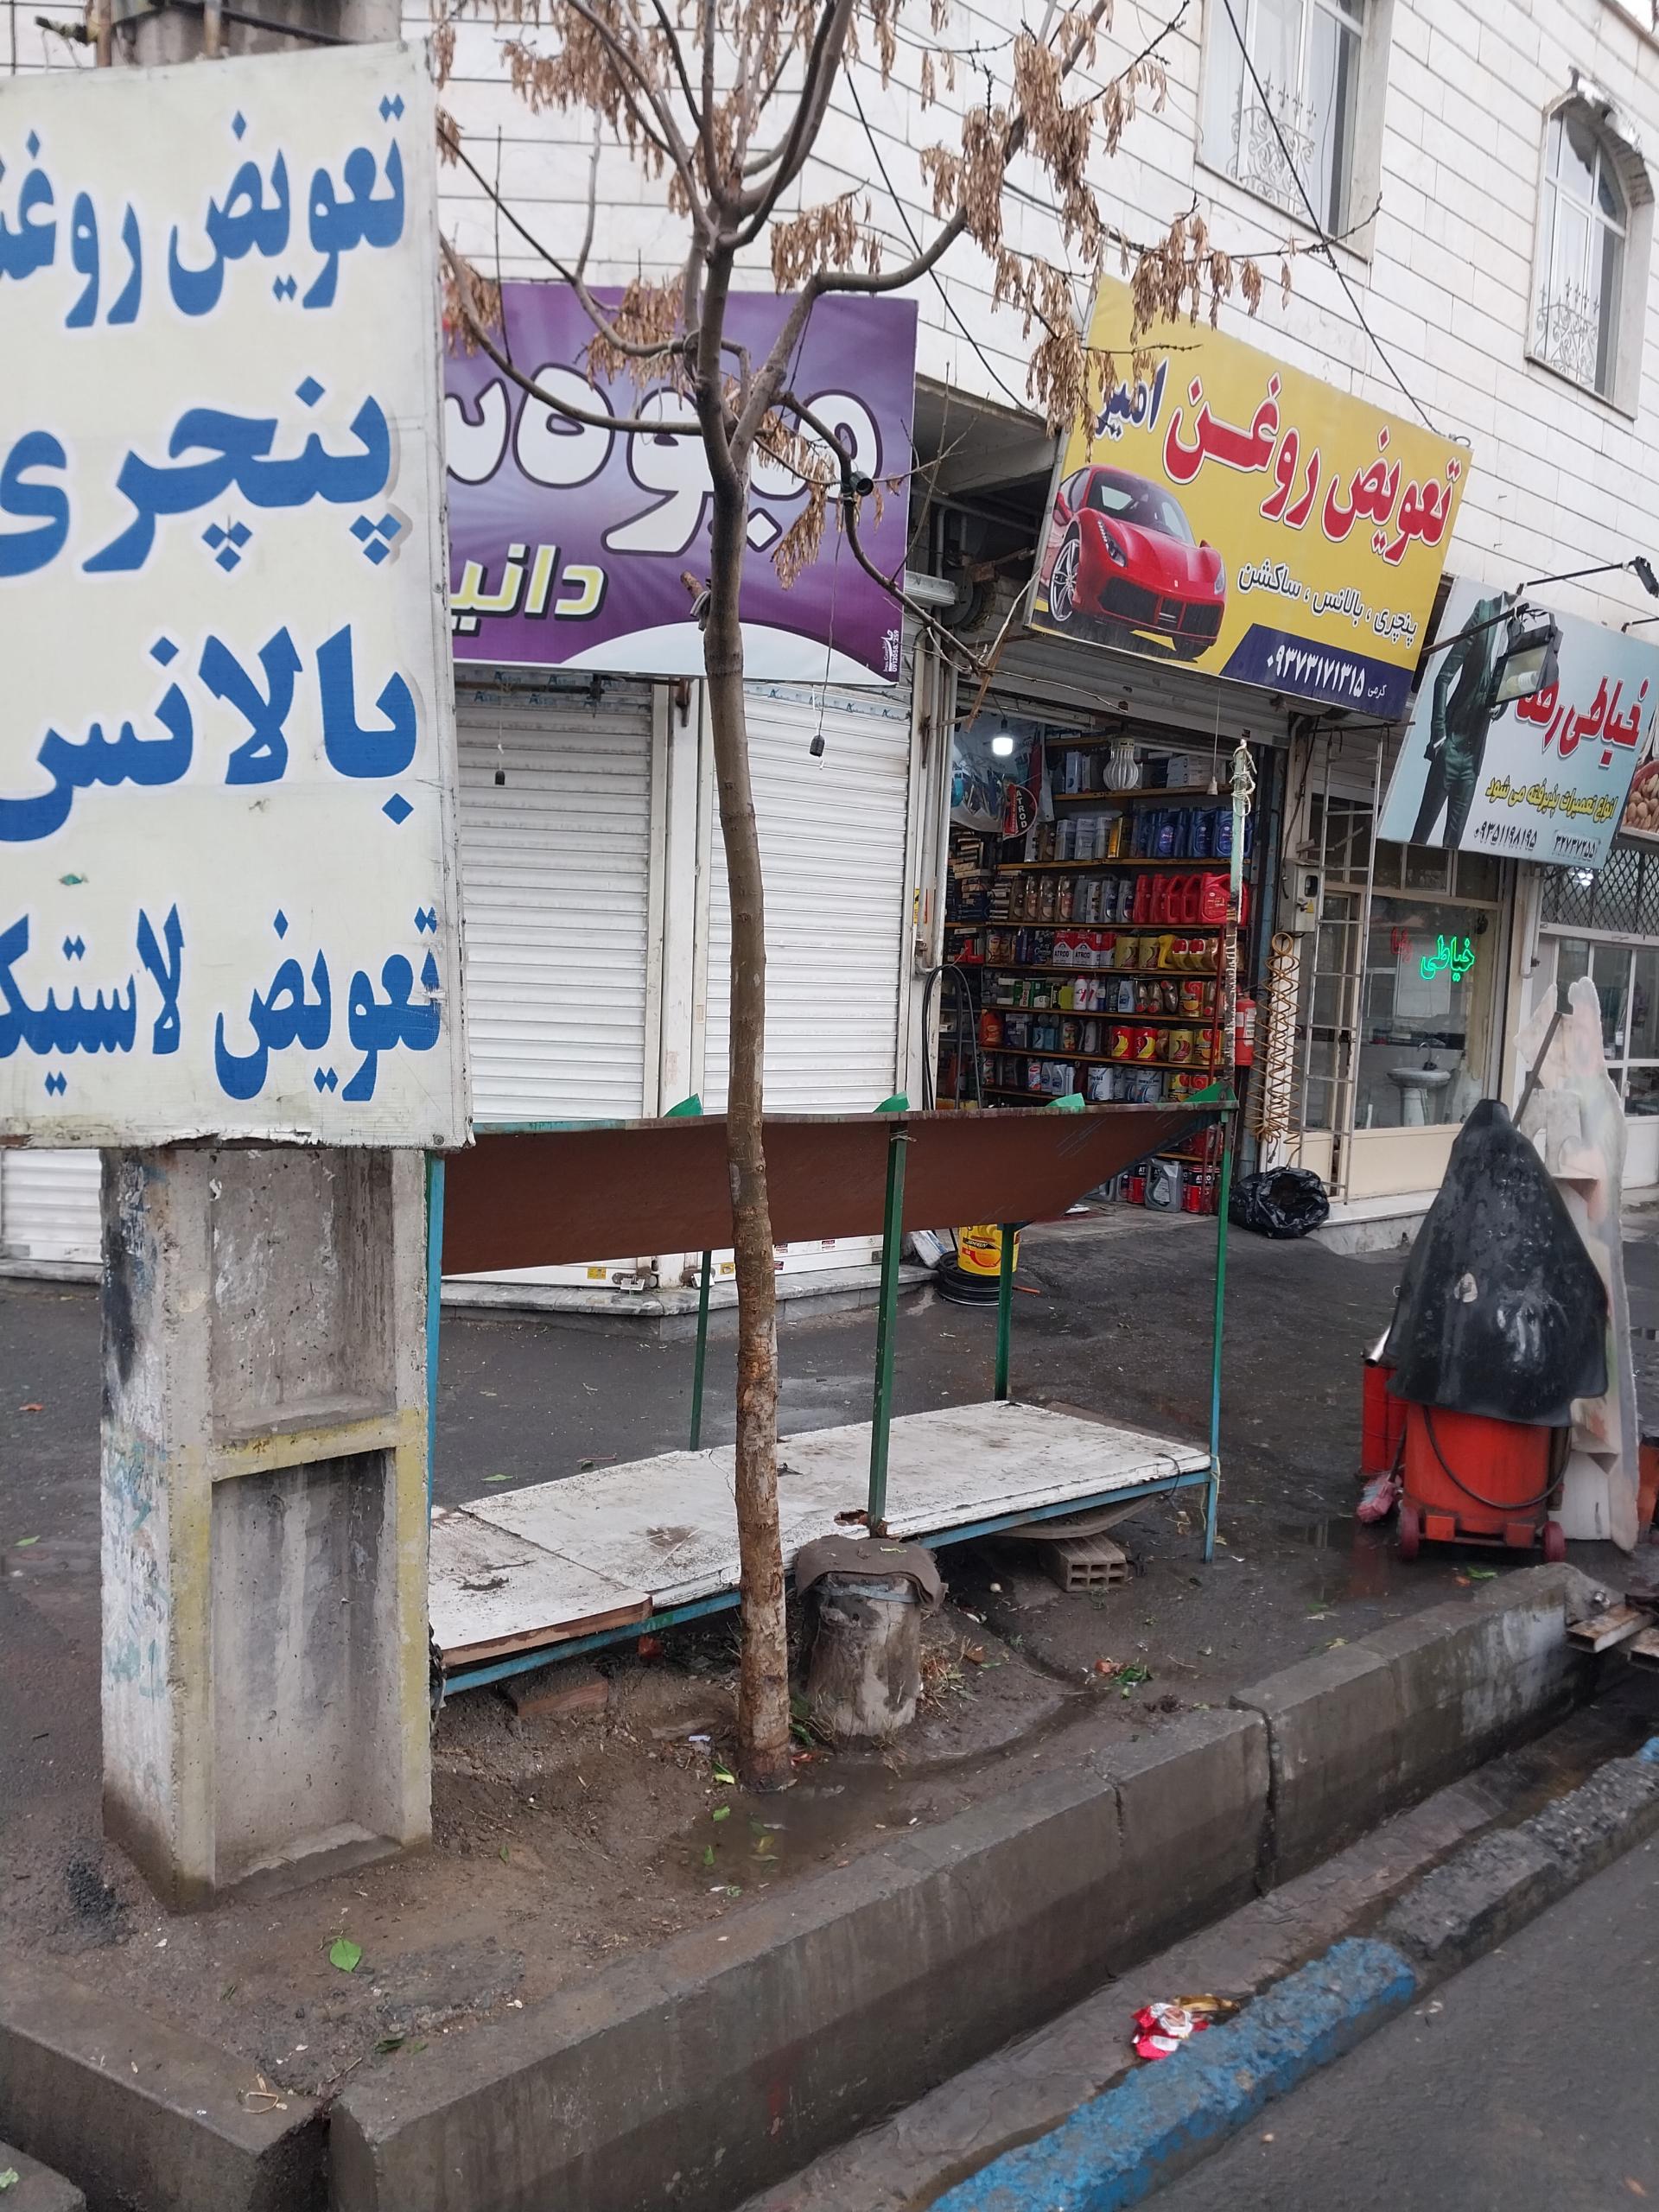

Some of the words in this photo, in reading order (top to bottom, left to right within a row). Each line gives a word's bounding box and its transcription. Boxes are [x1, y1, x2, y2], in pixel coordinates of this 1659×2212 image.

[0, 129, 143, 328] روغ
[168, 92, 406, 317] تعویض
[1095, 356, 1169, 441] امیر
[0, 375, 403, 578] پنچری
[1163, 372, 1322, 531] روغن
[1323, 426, 1461, 566] تعویض
[450, 543, 608, 637] دانی
[1236, 558, 1302, 601] ساکشن
[1311, 587, 1363, 627] بالانس
[1373, 608, 1418, 649] پنچری
[1267, 645, 1366, 698] ۰۹۳۷۳۱۷۱۳۱۵
[1367, 683, 1388, 701] کرمی
[0, 623, 417, 842] بالانس
[1515, 677, 1565, 753] رض
[1558, 673, 1649, 768] خیاطی
[1016, 789, 1027, 828] ATROD
[1485, 774, 1510, 803] شود
[1508, 785, 1527, 807] می
[1526, 777, 1560, 819] پذیرفته
[1559, 787, 1598, 819] تعمیرات
[1593, 794, 1619, 823] انواع
[1421, 934, 1475, 982] خیاطی
[214, 906, 440, 1102] تعویض
